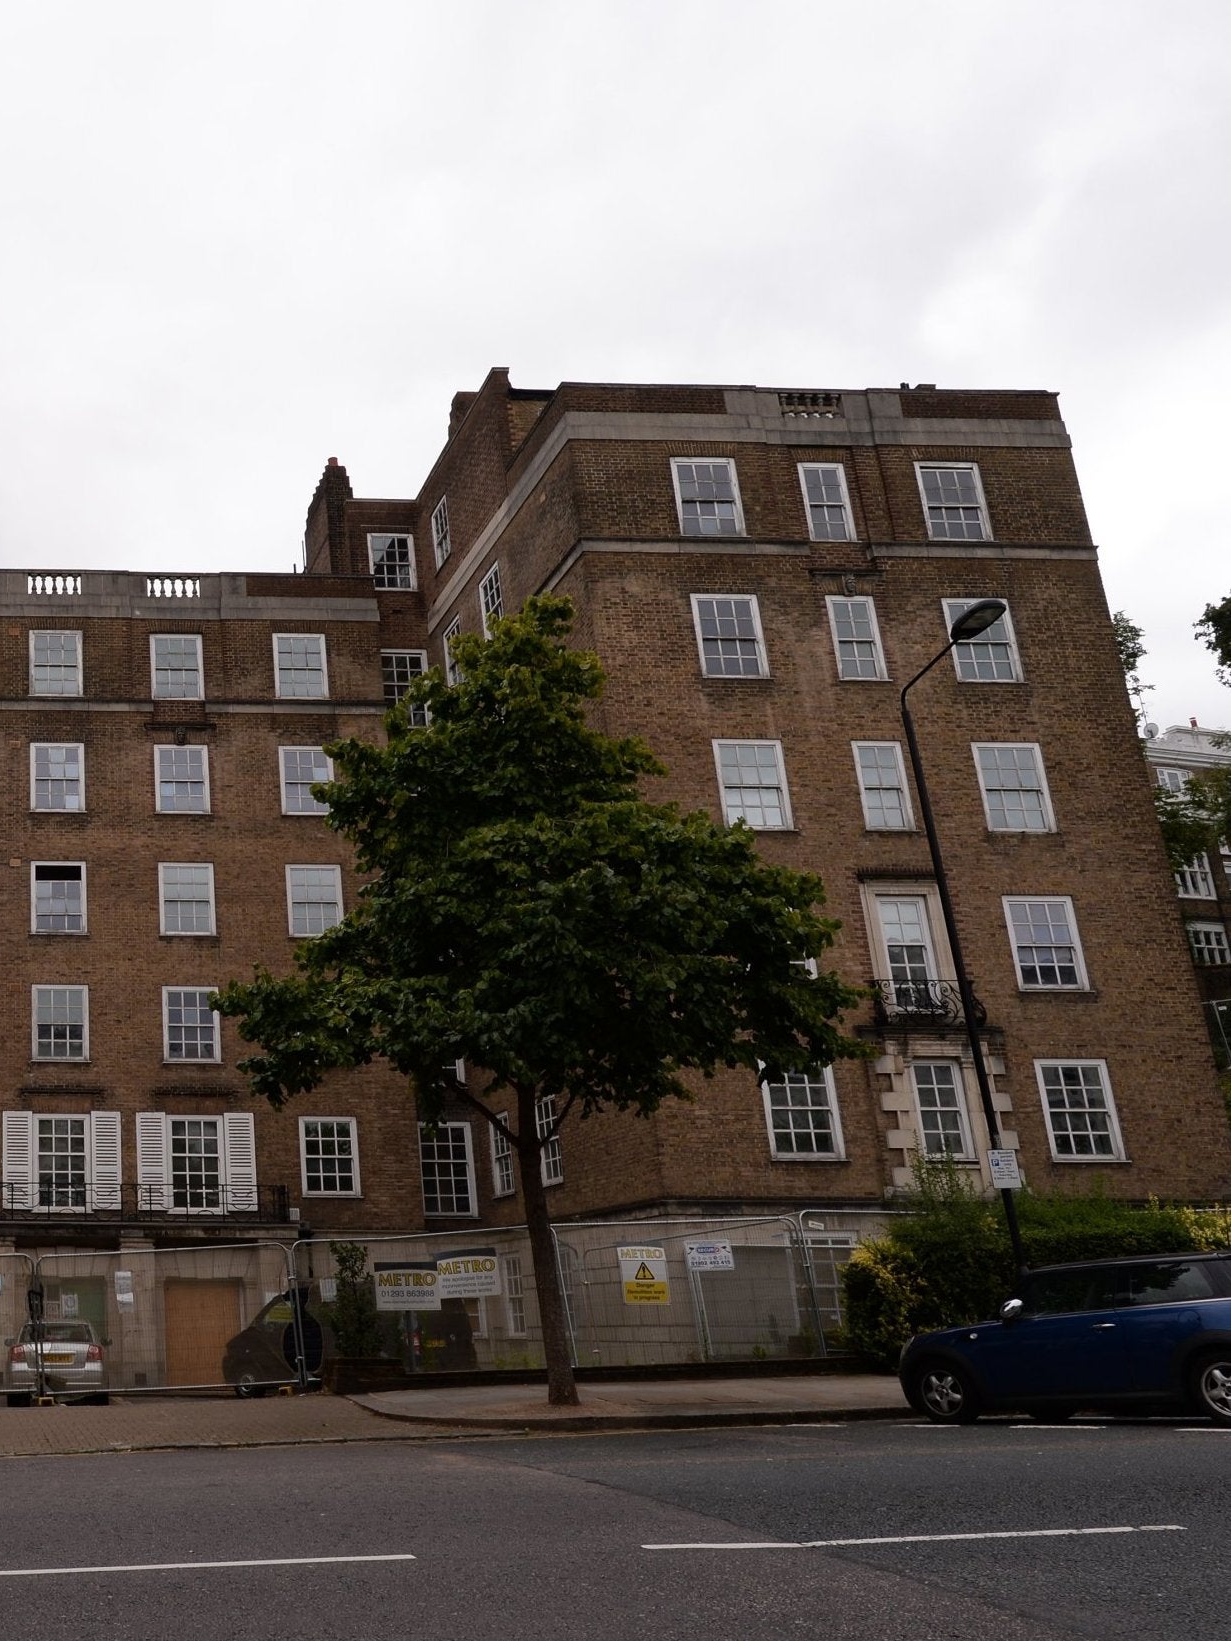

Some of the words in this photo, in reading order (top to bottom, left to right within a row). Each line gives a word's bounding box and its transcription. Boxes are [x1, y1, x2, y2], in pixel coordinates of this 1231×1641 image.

[621, 1248, 663, 1259] METRO
[438, 1259, 495, 1275] METRO
[379, 1273, 436, 1287] METRO
